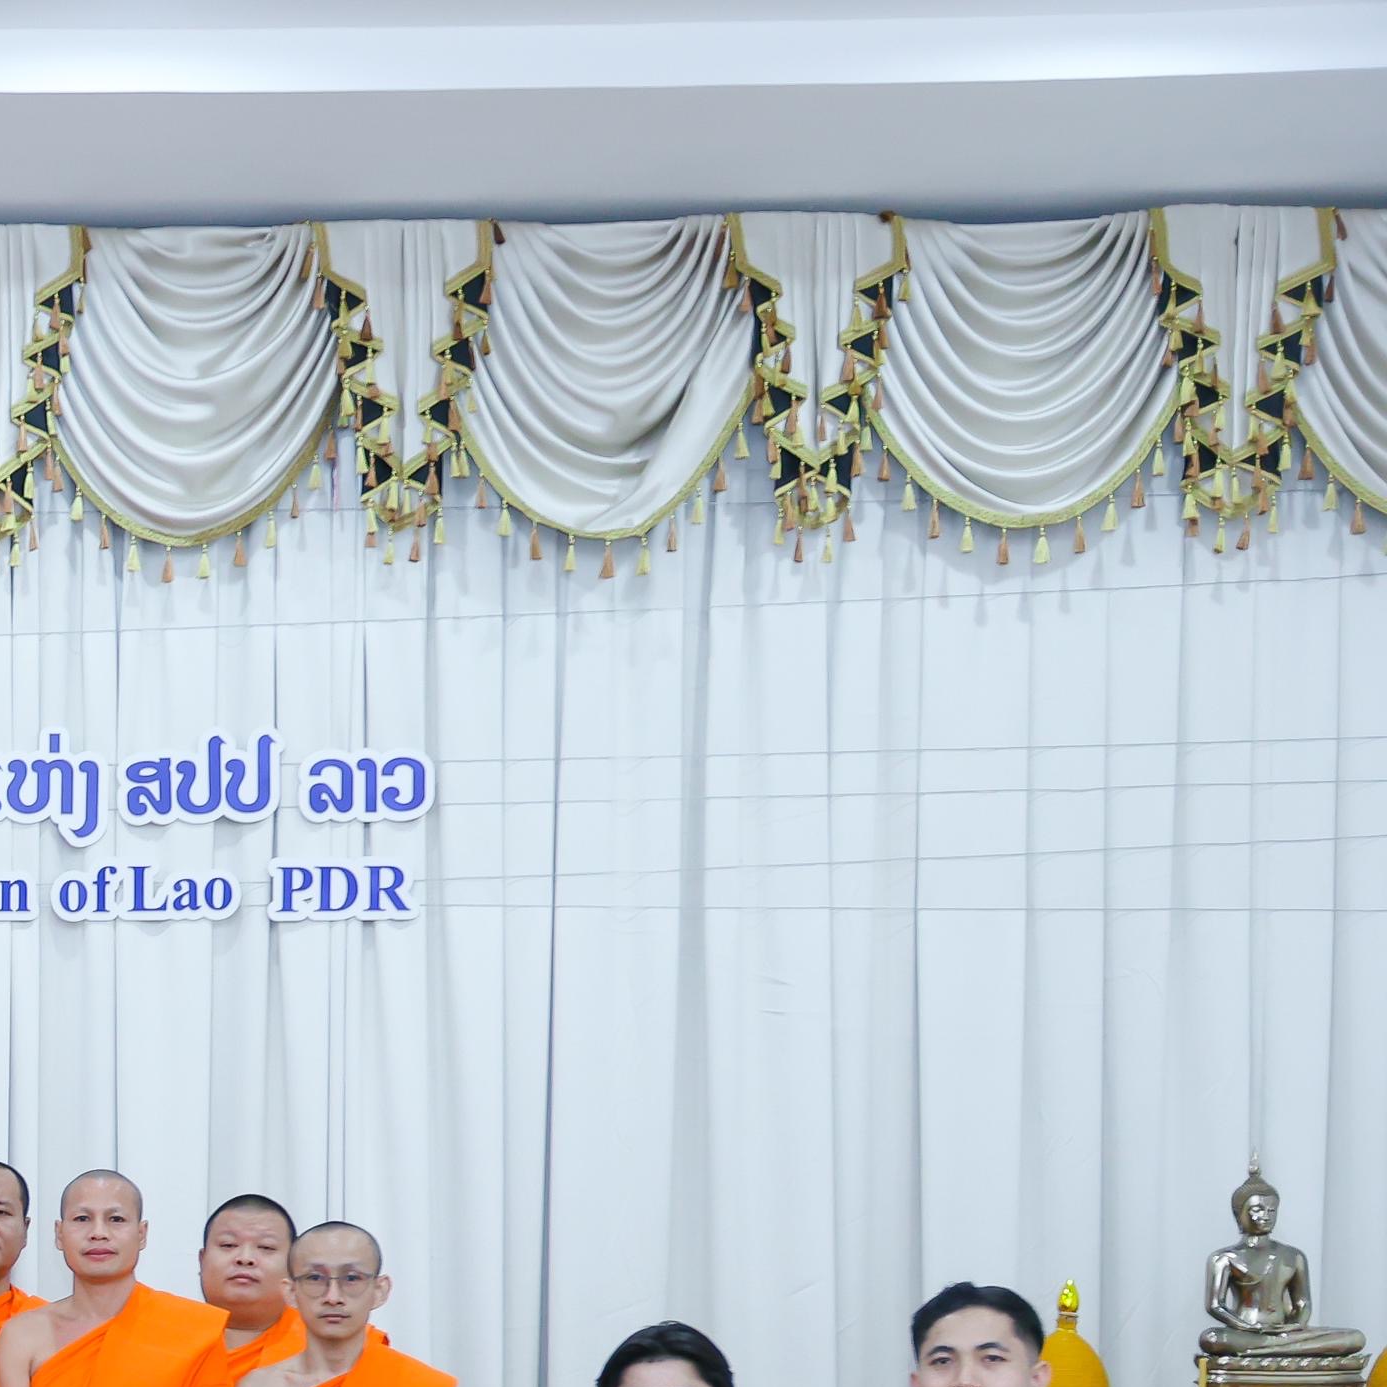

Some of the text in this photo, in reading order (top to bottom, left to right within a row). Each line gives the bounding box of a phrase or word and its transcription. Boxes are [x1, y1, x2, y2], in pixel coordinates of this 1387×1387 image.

[125, 734, 275, 816] ສປປ
[308, 756, 427, 815] ລາວ
[59, 864, 118, 913] of
[123, 865, 233, 913] Lao
[278, 864, 411, 913] PDR
